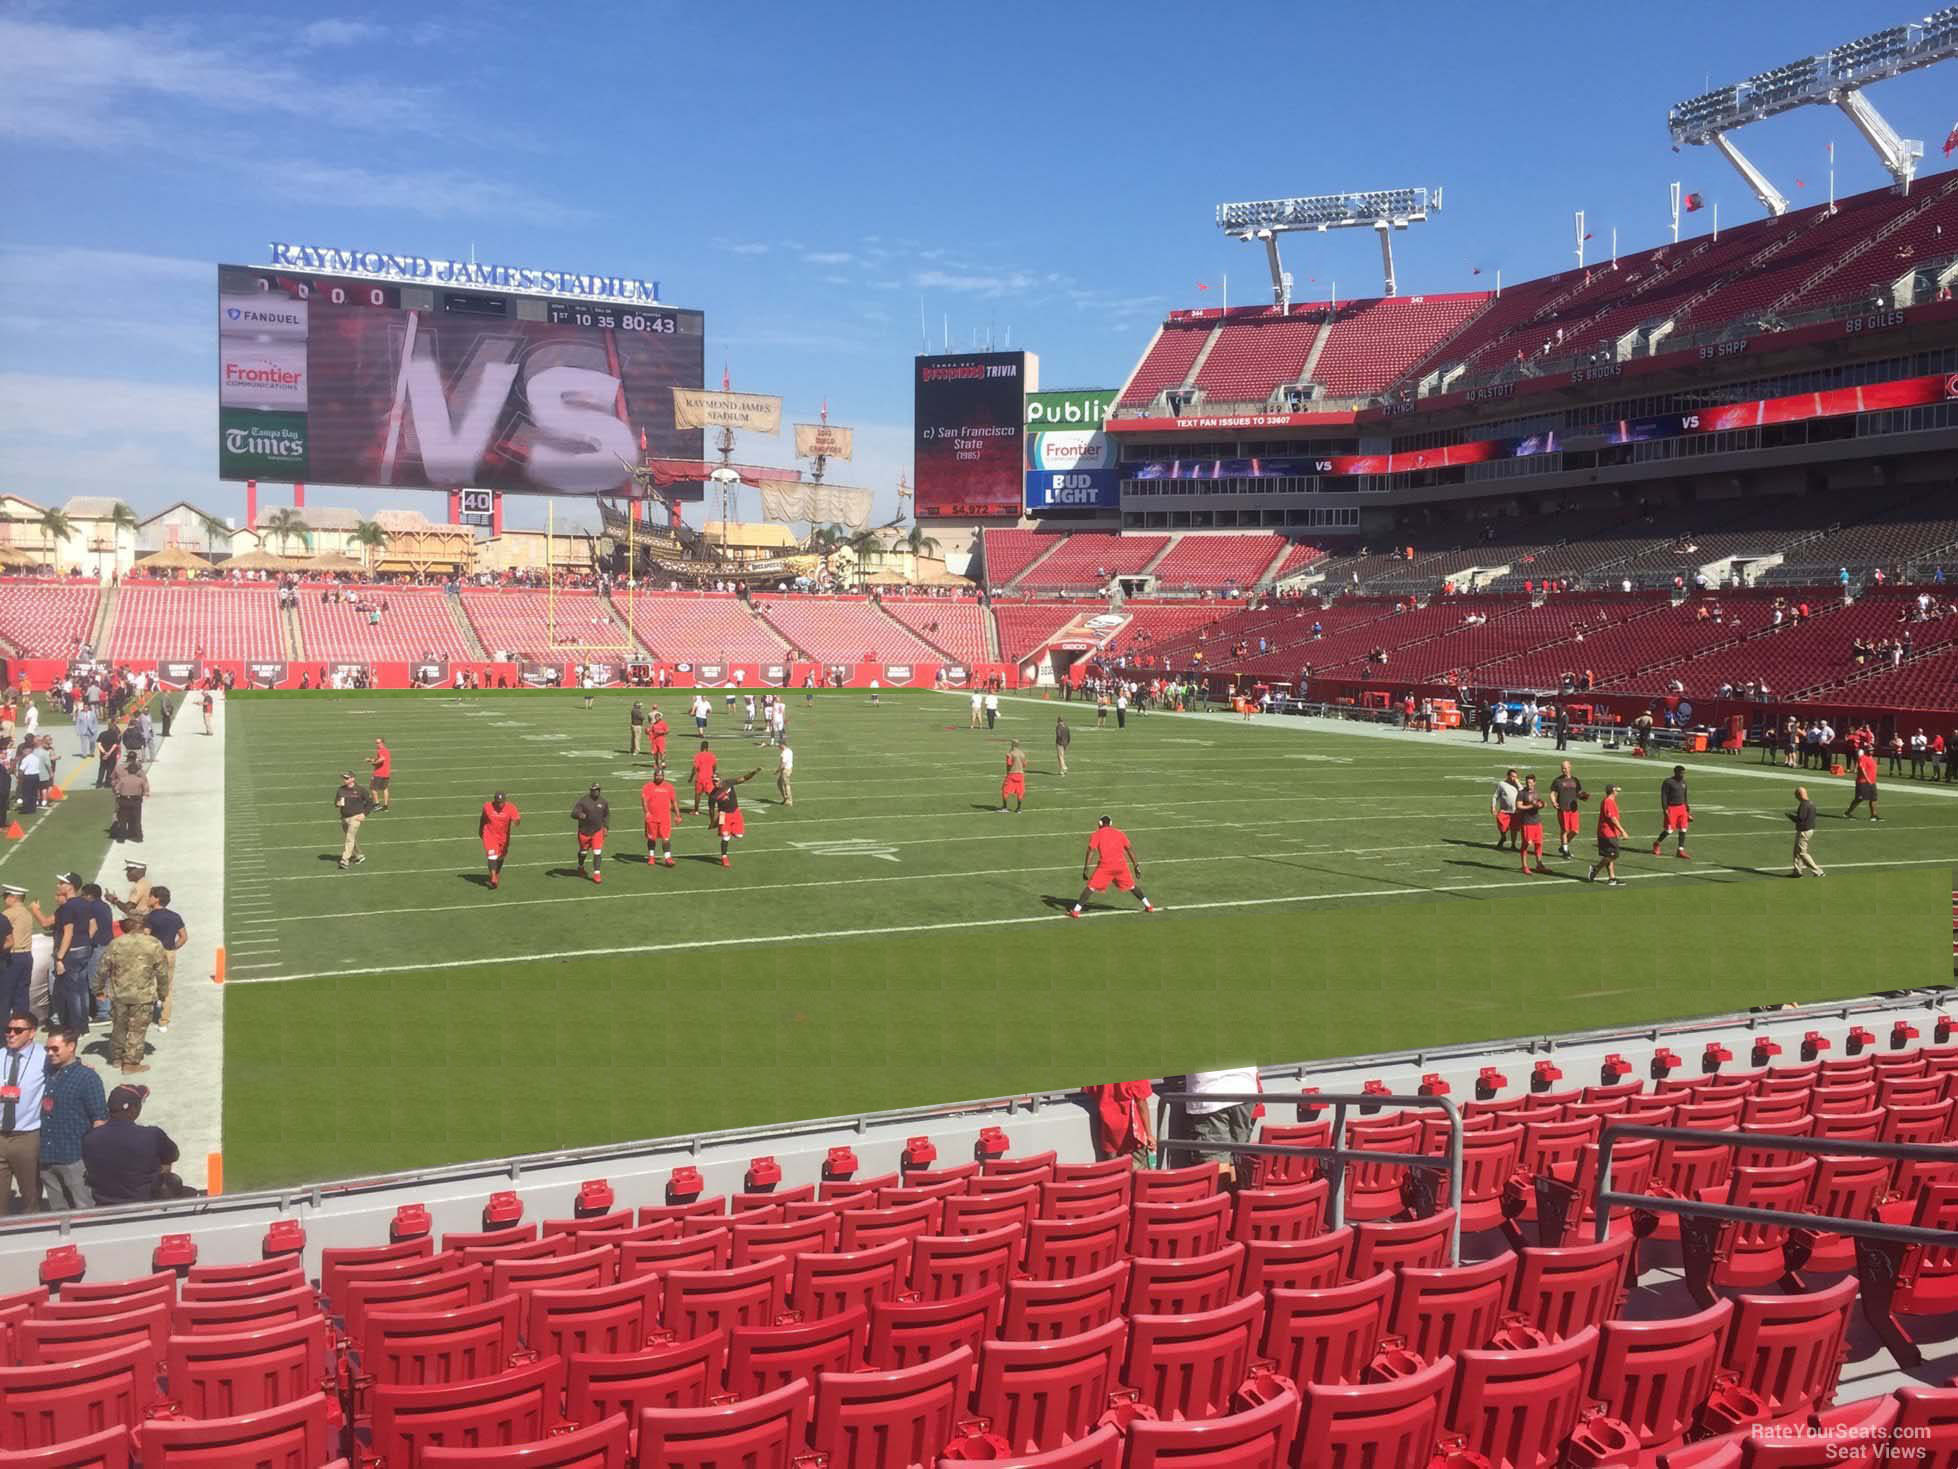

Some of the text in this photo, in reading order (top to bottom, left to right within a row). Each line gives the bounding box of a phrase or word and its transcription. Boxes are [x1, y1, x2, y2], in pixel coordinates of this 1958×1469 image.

[270, 242, 661, 301] RAYMOND JAMES STADIUM
[331, 288, 345, 304] 0
[370, 289, 385, 305] 0
[244, 311, 299, 325] FANDUEL
[576, 314, 591, 326] 10
[597, 316, 615, 328] 35
[622, 315, 675, 333] 80:43
[1868, 311, 1904, 330] GILES
[1718, 340, 1747, 355] SAPP
[226, 363, 303, 385] Frontier
[986, 365, 1017, 378] TRIVIA
[686, 399, 771, 413] RAYMOND JAMES
[1176, 419, 1198, 427] TEXT
[1200, 418, 1217, 426] FAN
[1219, 418, 1250, 426] ISSUES
[1253, 417, 1264, 425] TO
[1682, 415, 1700, 429] VS
[938, 426, 958, 438] San
[961, 425, 1015, 438] Francisco
[226, 428, 304, 456] Times
[954, 438, 983, 450] State
[1046, 442, 1102, 456] Frontier
[1315, 460, 1333, 472] VS
[1052, 474, 1092, 489] BUD
[465, 492, 490, 509] 40
[1044, 488, 1099, 504] LIGHT
